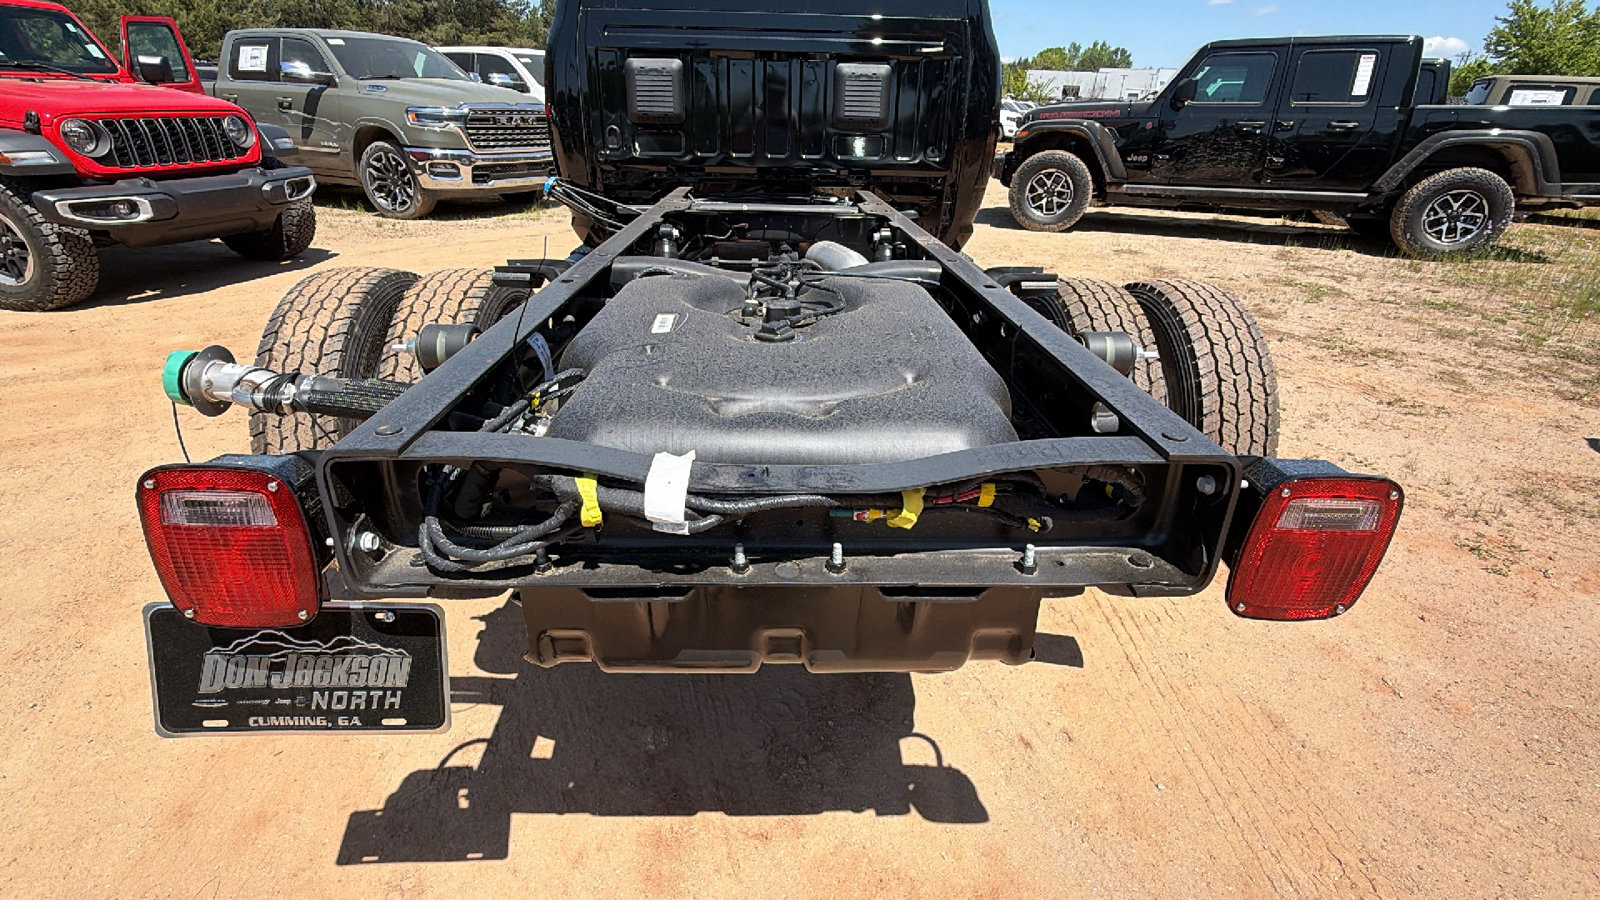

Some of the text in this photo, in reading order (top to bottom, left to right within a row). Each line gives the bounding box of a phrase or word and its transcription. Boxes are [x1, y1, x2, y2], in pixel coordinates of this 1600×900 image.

[1127, 153, 1148, 162] Jeep
[198, 651, 412, 693] DON JACKSON
[311, 690, 402, 710] NORTH
[248, 716, 362, 728] CUMMING, GA
